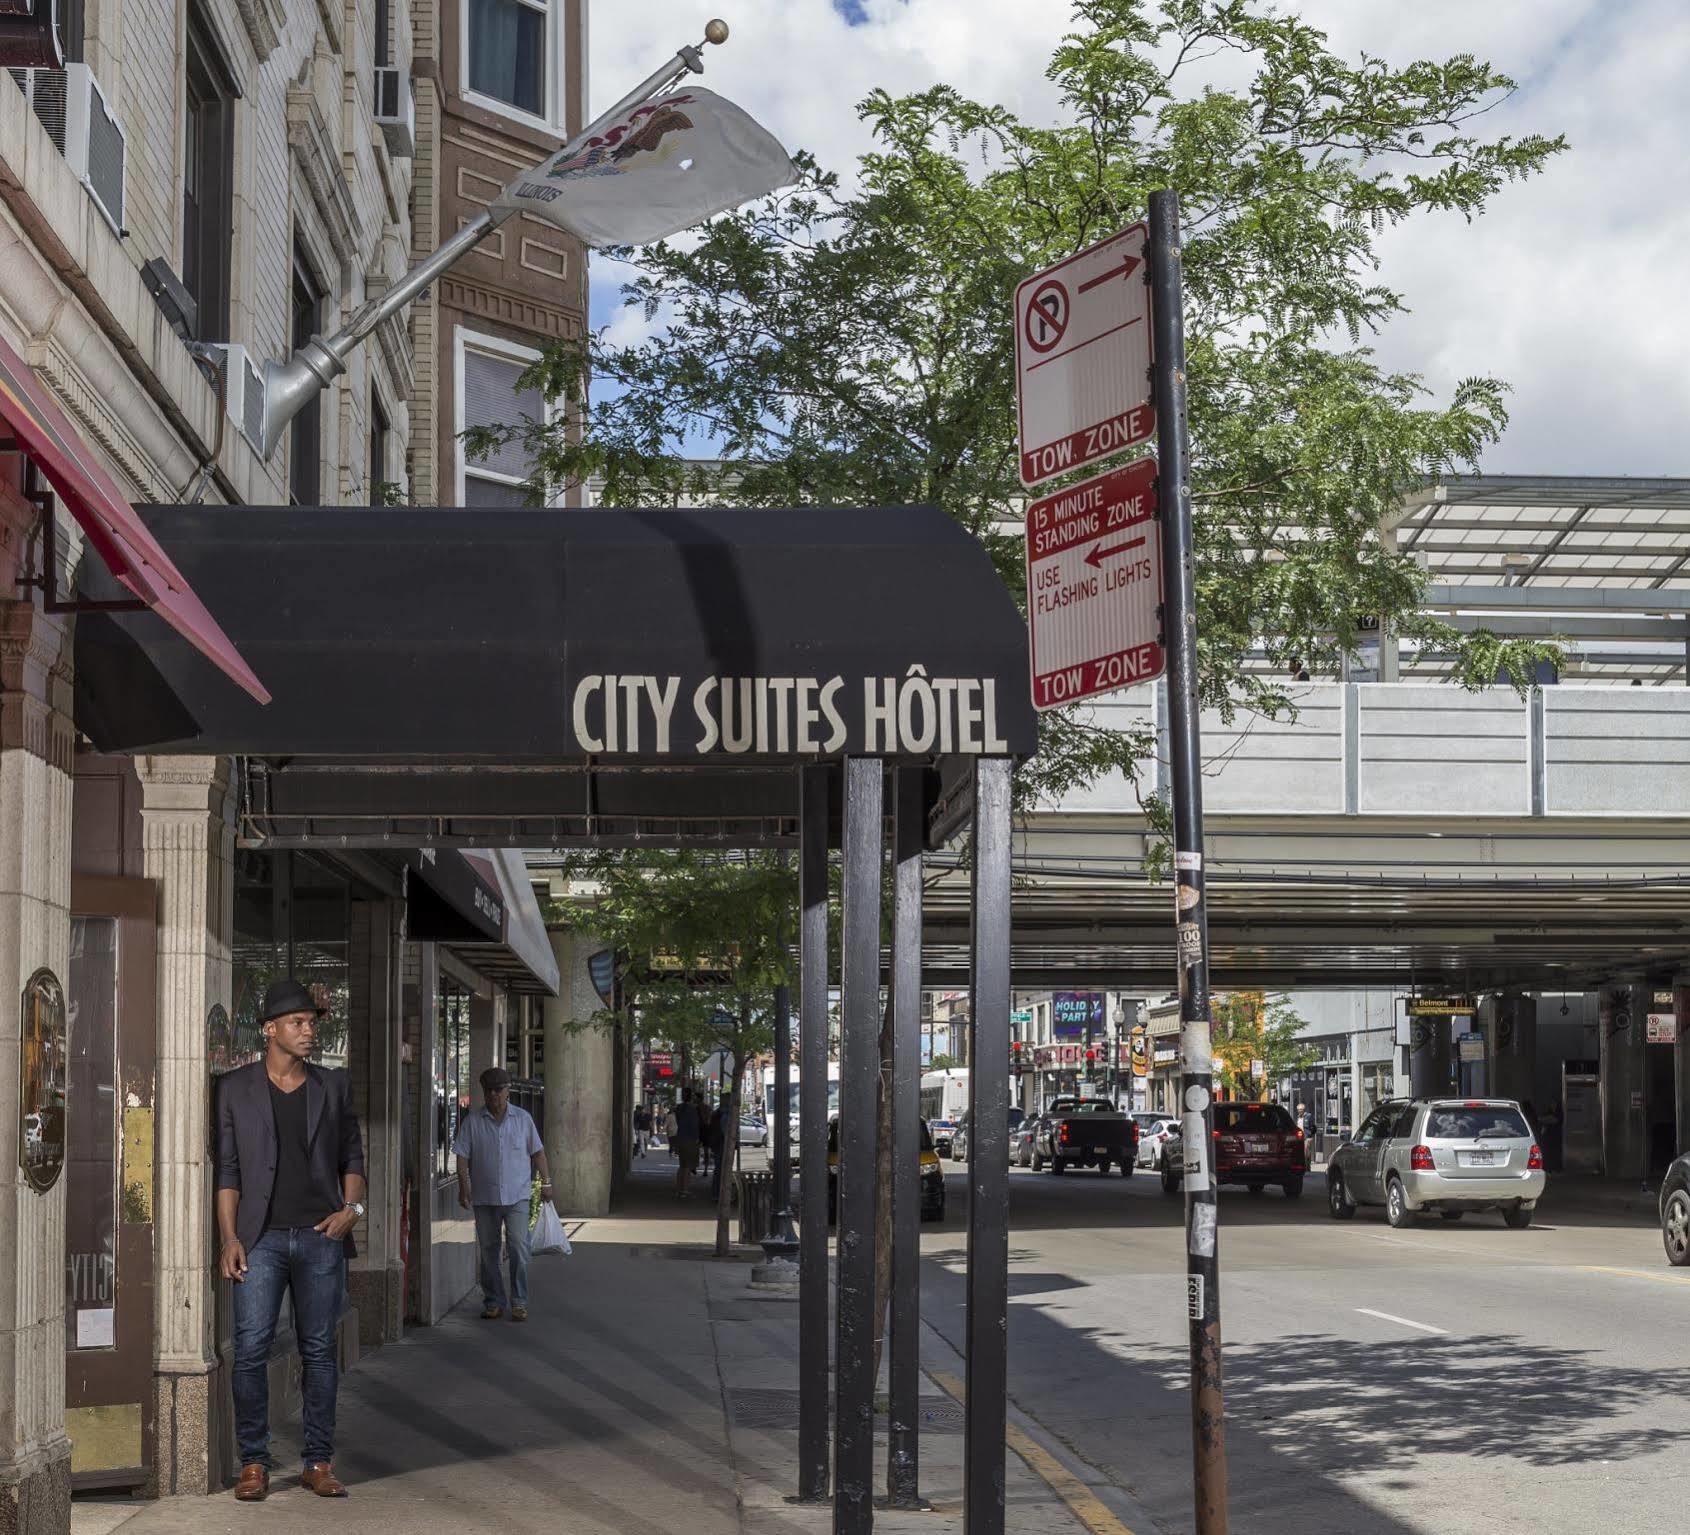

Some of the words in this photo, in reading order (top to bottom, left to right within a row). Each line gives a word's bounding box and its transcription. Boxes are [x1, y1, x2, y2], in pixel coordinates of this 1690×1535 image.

[515, 182, 563, 202] ILLINOIS
[1030, 440, 1072, 477] TOW
[1085, 411, 1143, 456] ZONE
[1034, 509, 1048, 529] 15
[1055, 486, 1104, 523] MINUTE
[1036, 515, 1100, 553] STANDING
[1107, 495, 1144, 528] ZONE
[1037, 566, 1060, 590] USE
[1038, 576, 1098, 615] FLASHING
[1106, 559, 1151, 592] LIGHTS
[1041, 667, 1082, 702] TOW
[1095, 648, 1152, 688] ZONE
[573, 675, 680, 753] CITY
[693, 675, 847, 753] SUITES
[864, 664, 1008, 753] HÔTEL
[1179, 930, 1200, 943] 100
[1055, 1001, 1099, 1011] HOLIDY
[1061, 1012, 1095, 1021] PART
[1420, 999, 1449, 1008] Belmont
